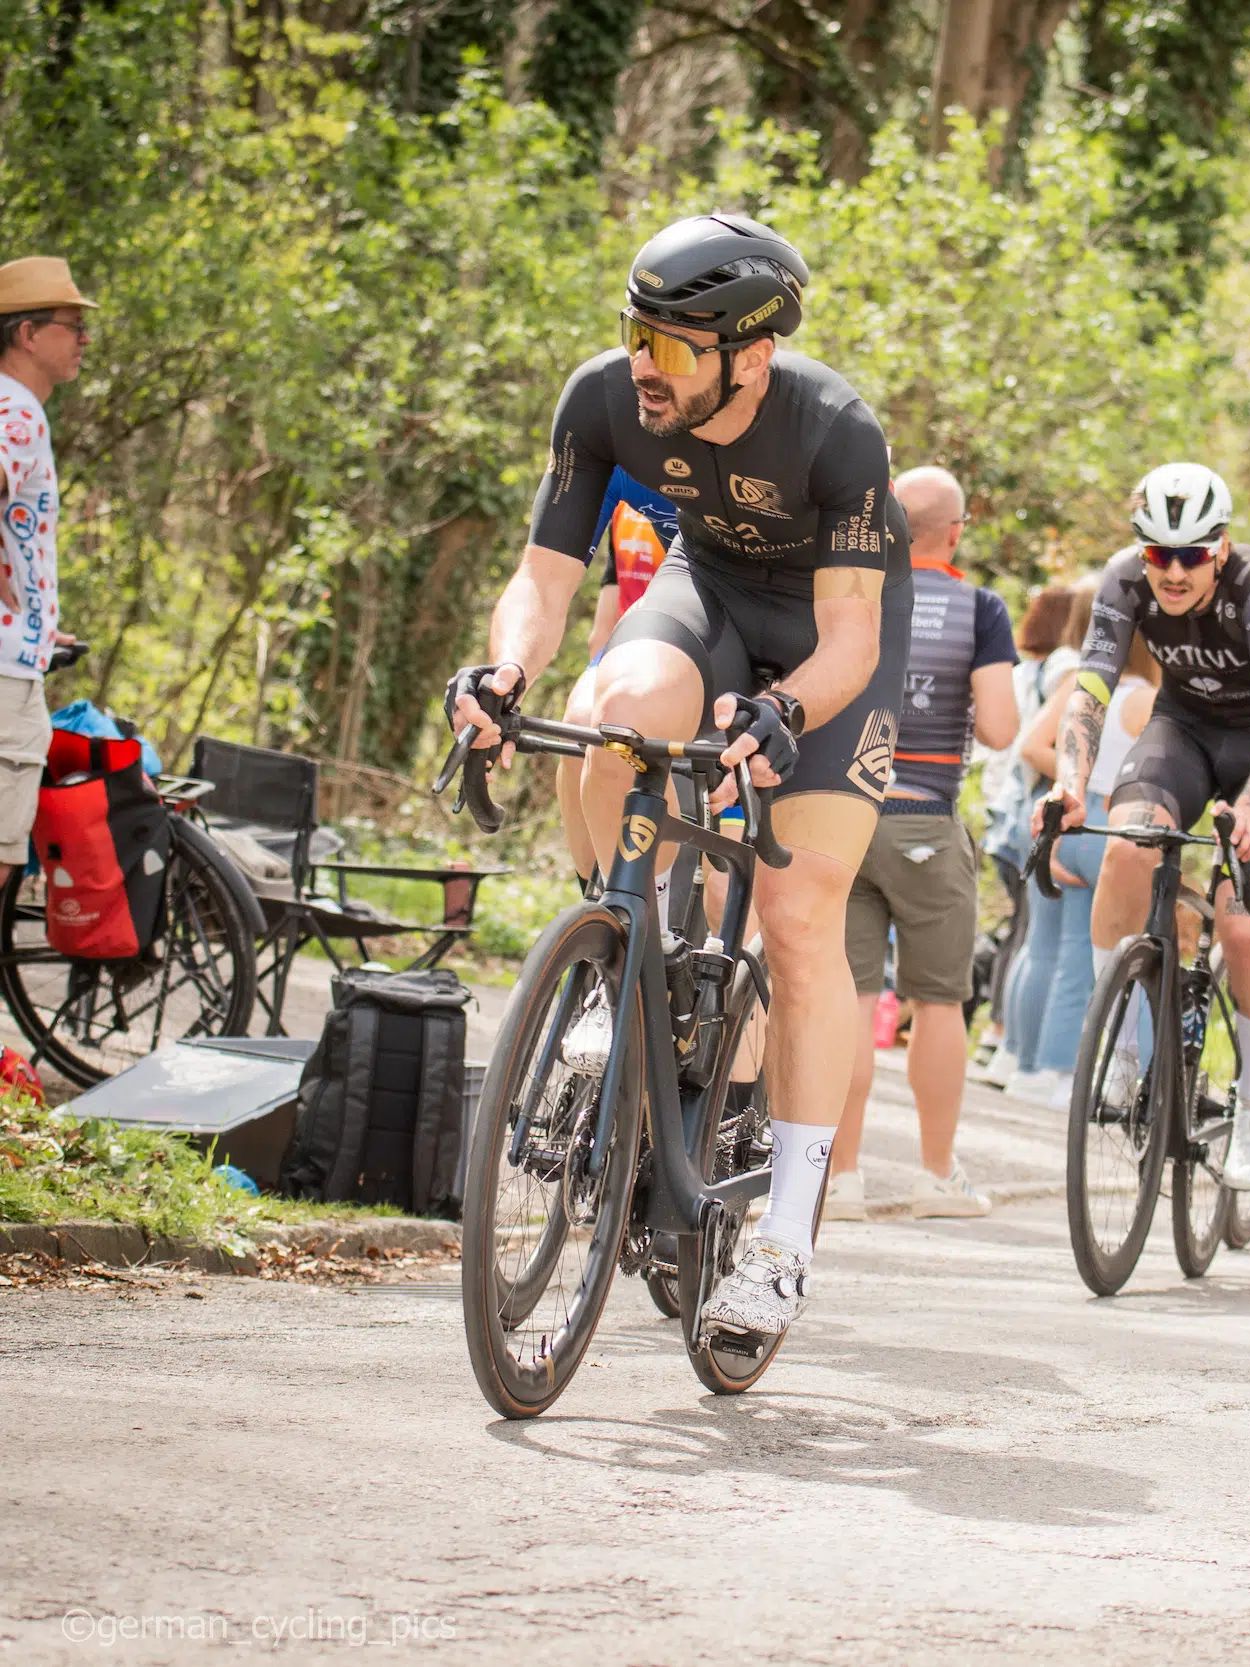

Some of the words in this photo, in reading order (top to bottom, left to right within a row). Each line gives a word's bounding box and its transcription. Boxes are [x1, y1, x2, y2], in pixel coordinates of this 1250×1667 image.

[744, 300, 779, 330] ABUS
[666, 486, 695, 495] ABUS
[847, 516, 861, 551] SPIEGL
[860, 487, 876, 552] WOLFGANG
[836, 521, 848, 552] GMBH
[869, 531, 878, 553] ING
[722, 1346, 749, 1356] GARMIN
